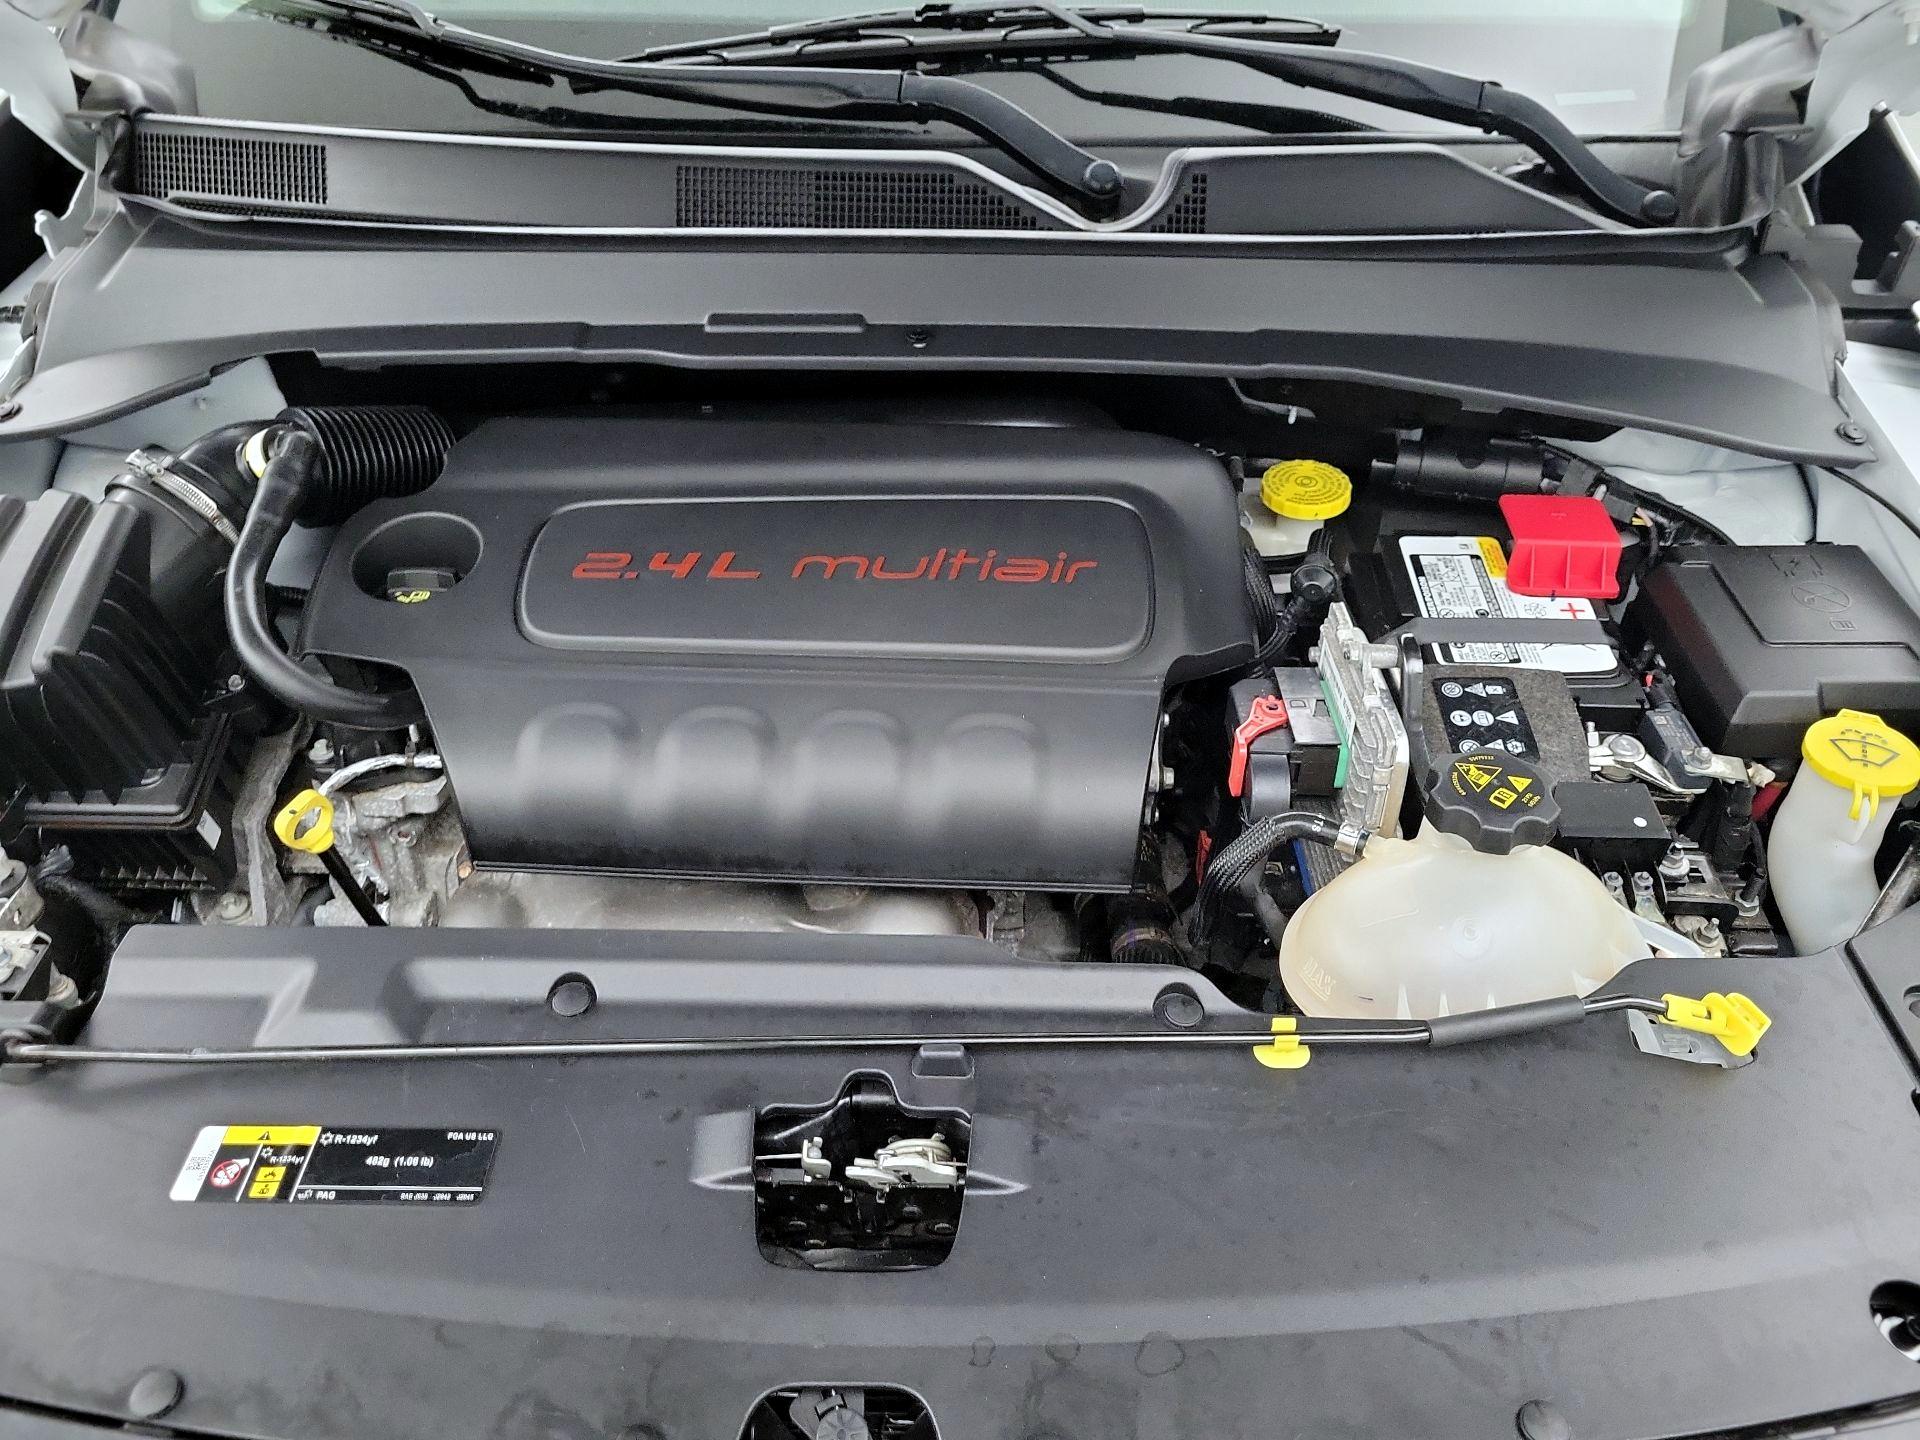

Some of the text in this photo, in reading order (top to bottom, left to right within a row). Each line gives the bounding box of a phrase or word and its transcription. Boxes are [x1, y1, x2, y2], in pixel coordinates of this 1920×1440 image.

[791, 548, 1097, 583] multiair
[335, 1135, 378, 1146] R-1234yf
[270, 1155, 304, 1165] R-1234yf
[316, 1191, 336, 1200] PAG
